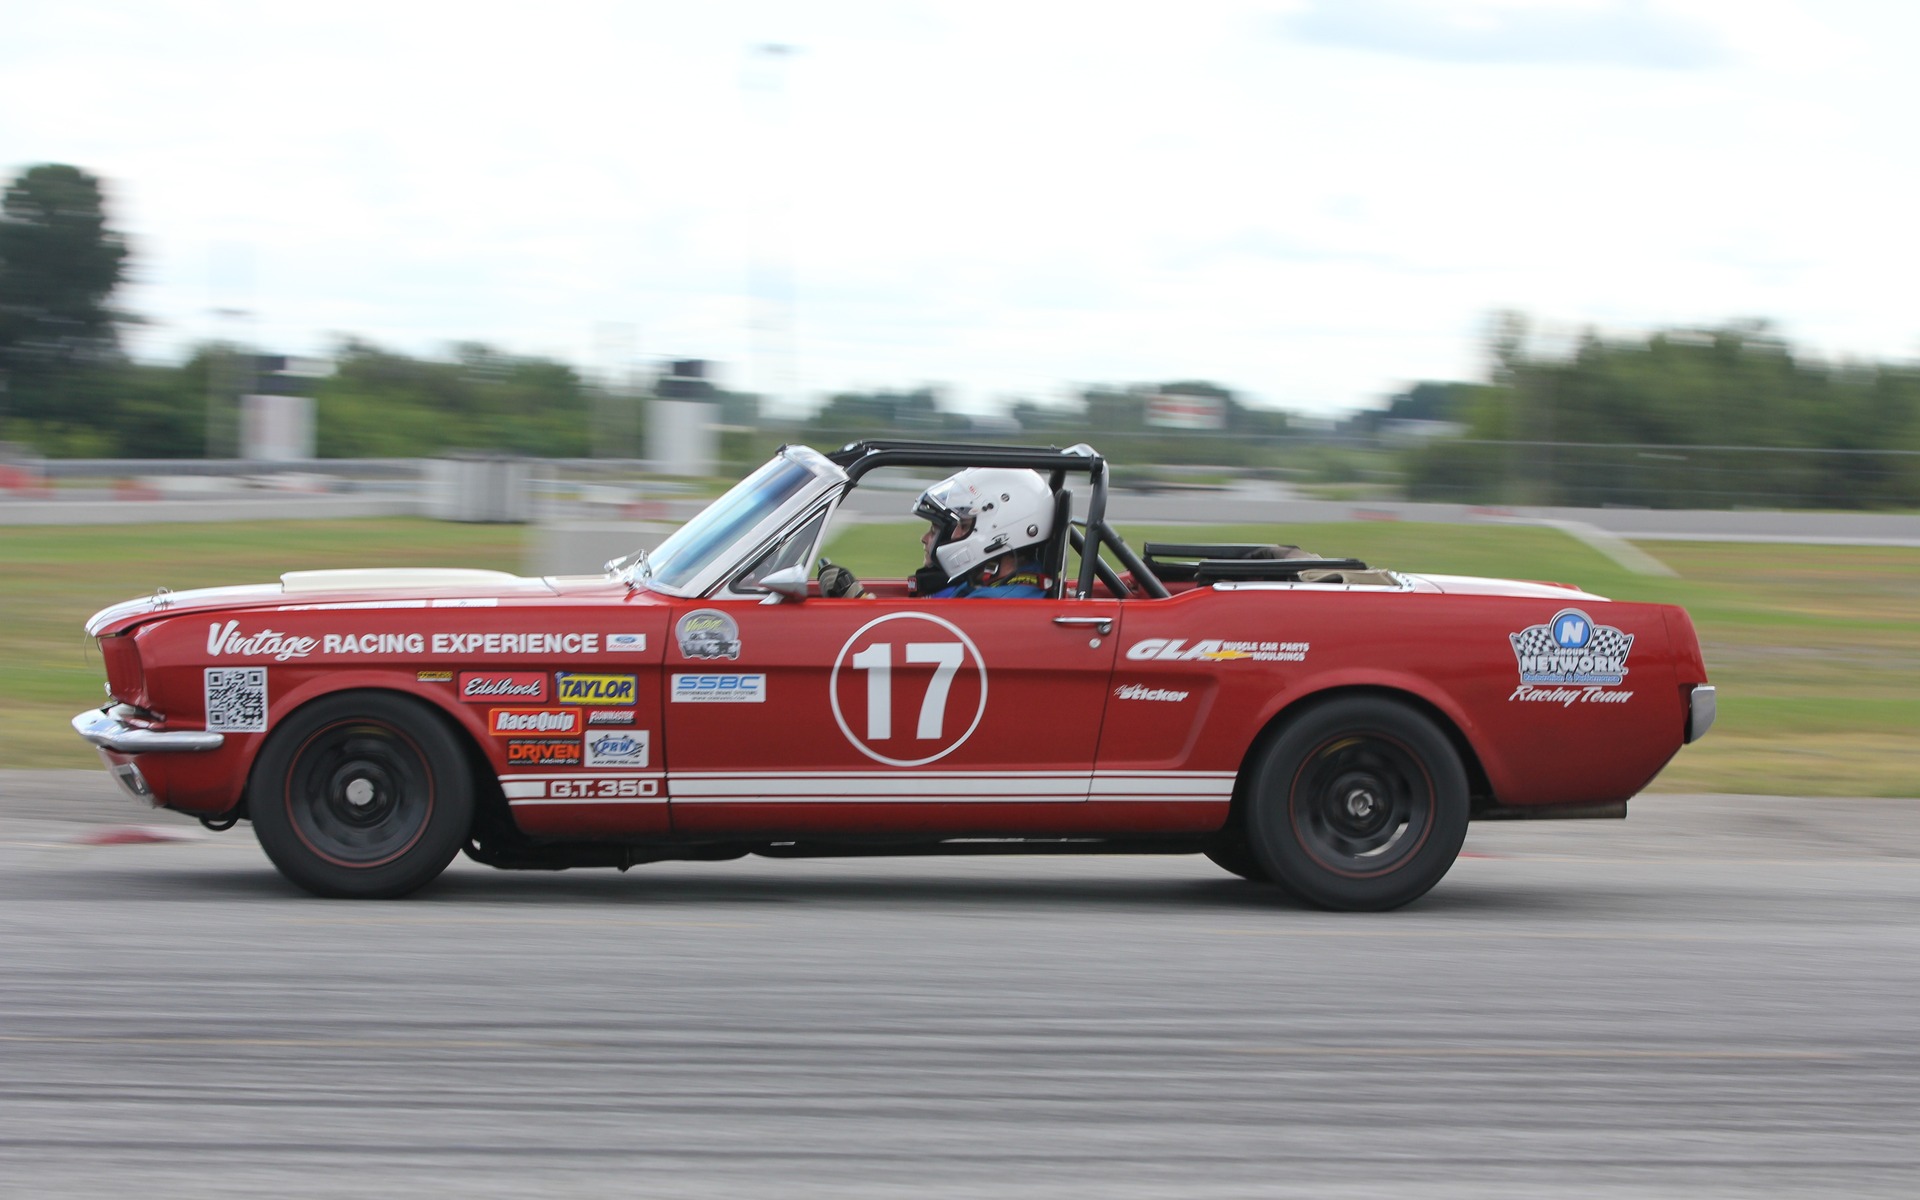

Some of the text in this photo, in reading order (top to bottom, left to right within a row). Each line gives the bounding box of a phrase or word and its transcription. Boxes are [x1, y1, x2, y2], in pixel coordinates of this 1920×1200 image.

[206, 619, 599, 662] Vintage RACING EXPERIENCE
[1560, 621, 1585, 643] N
[1126, 638, 1224, 661] GLA
[1223, 641, 1310, 651] MUSCLE CAR PARTS
[1252, 652, 1306, 661] MOULDINGS
[1521, 656, 1622, 672] NETWORK
[464, 677, 541, 696] Edelbrock
[562, 680, 631, 698] TAYLOR
[677, 675, 761, 689] SSBC
[852, 642, 965, 740] 17
[1118, 686, 1190, 702] Sticker
[1508, 685, 1634, 708] Racing Team
[495, 711, 575, 731] RaceQuip
[508, 744, 580, 764] DRIVEN
[600, 740, 635, 753] PRW
